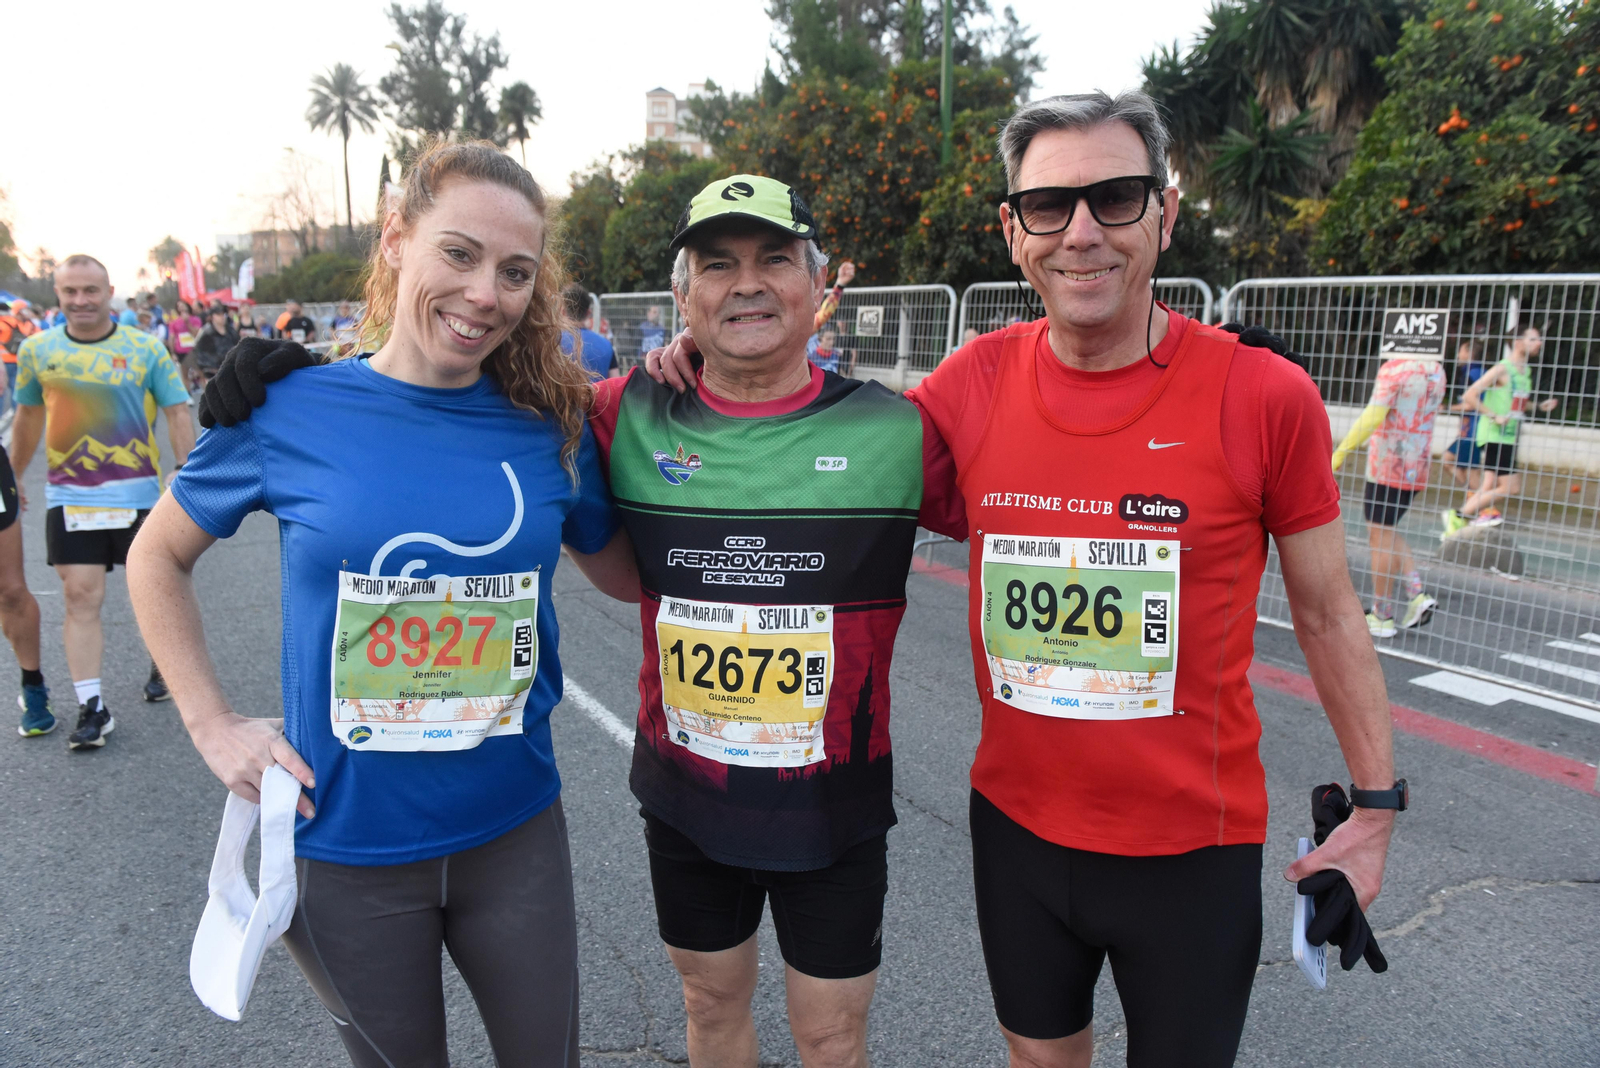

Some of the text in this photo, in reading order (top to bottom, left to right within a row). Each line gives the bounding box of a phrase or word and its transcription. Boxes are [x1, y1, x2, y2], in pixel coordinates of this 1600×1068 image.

[1393, 313, 1439, 335] AMS
[981, 492, 1113, 515] ATLETISME CLUB
[1125, 499, 1181, 518] L'aire
[1128, 523, 1178, 533] GRANOLLERS
[724, 536, 766, 549] CCRD
[992, 539, 1061, 558] MEDIO MARATÓN
[667, 548, 825, 571] FERROVIARIO
[1088, 540, 1147, 566] SEVILLA
[352, 577, 436, 596] MEDIO MARATÓN
[464, 575, 515, 598] SEVILLA
[703, 571, 785, 586] DE SEVILLA
[668, 601, 734, 623] MEDIO MARATÓN
[758, 608, 809, 629] SEVILLA
[1005, 579, 1123, 639] 8926
[340, 631, 349, 662] CAJÓN 4
[366, 615, 497, 667] 8927
[1043, 636, 1079, 648] Antonio
[670, 639, 802, 694] 12673
[1025, 654, 1097, 669] Rodriguez Gonzalez
[412, 670, 452, 680] Jennifer
[399, 690, 463, 699] Rodriguez Rubio
[708, 692, 756, 705] GUARNIDO
[1051, 696, 1080, 707] HOKA
[703, 708, 732, 720] Guarnido
[733, 713, 762, 722] Centeno
[423, 728, 453, 739] HOKA
[724, 747, 749, 757] HOKA
